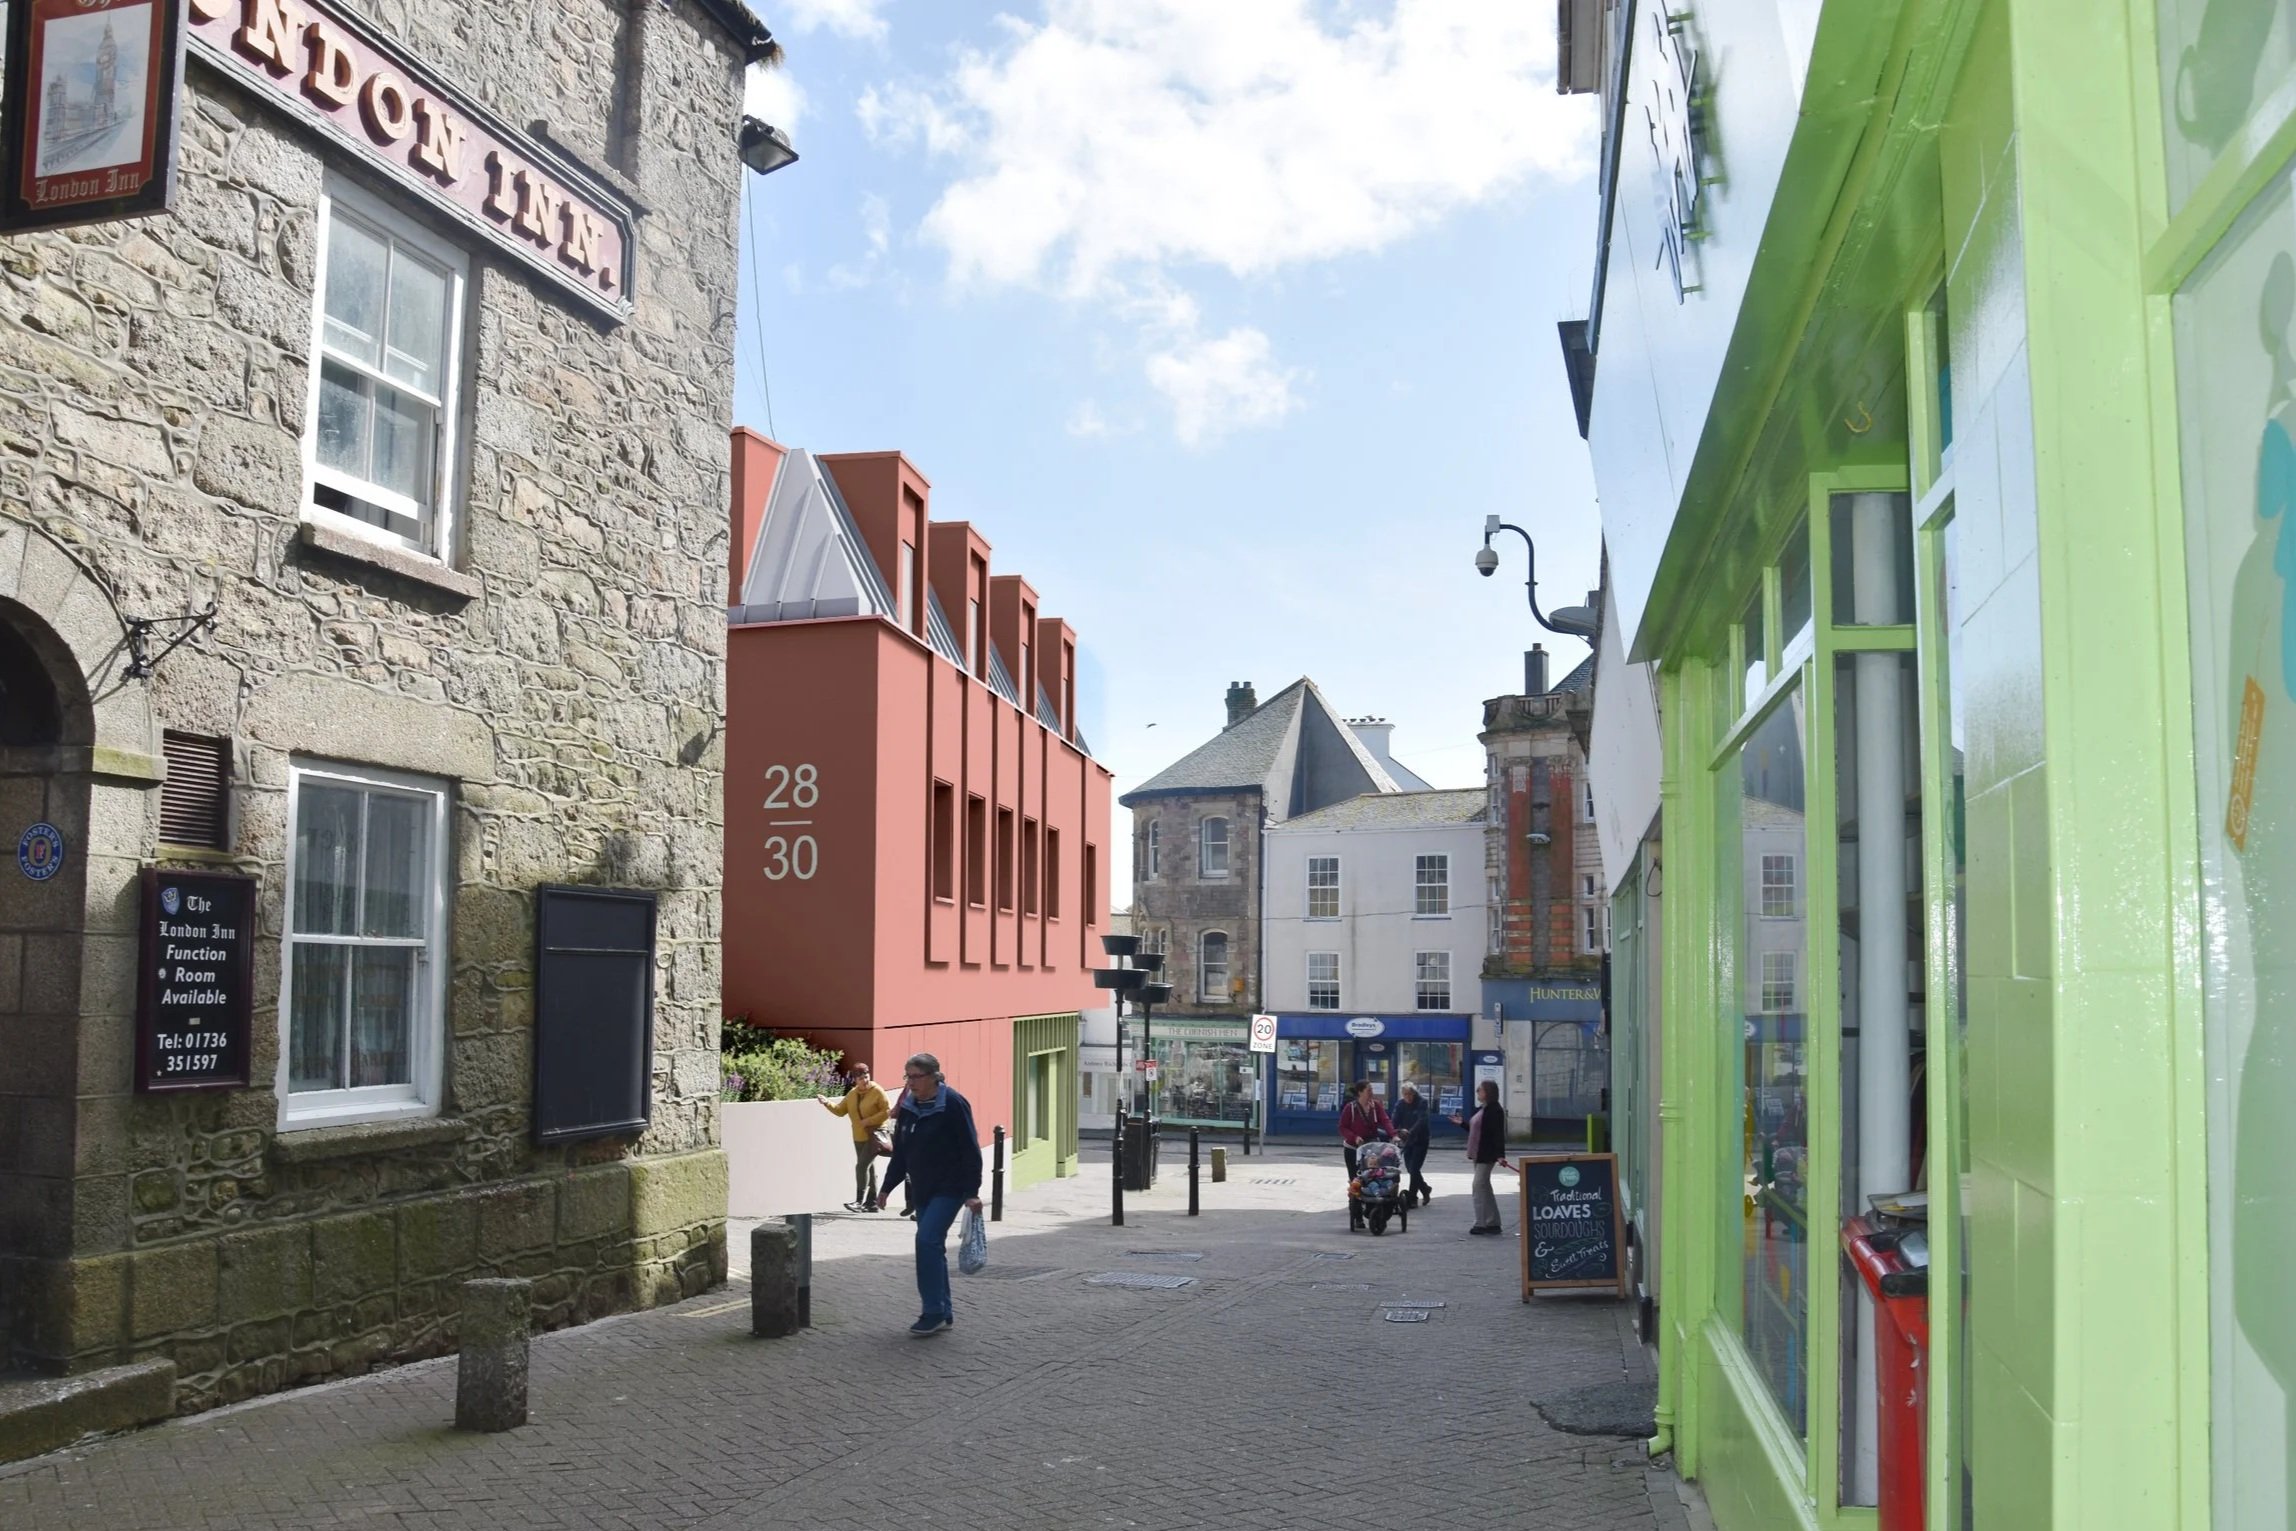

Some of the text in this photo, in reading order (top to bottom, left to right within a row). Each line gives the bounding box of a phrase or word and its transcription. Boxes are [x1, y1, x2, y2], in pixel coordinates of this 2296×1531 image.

[35, 168, 140, 204] London Inn
[763, 763, 819, 809] 28
[763, 835, 818, 880] 30
[187, 895, 212, 913] The
[159, 920, 236, 939] London Inn
[166, 944, 227, 961] Function
[175, 966, 216, 982] Room
[161, 988, 227, 1005] Available
[1256, 1024, 1272, 1035] 20
[157, 1032, 227, 1050] Tel: 01736
[1253, 1042, 1273, 1050] ZONE
[166, 1054, 218, 1072] 351597
[1532, 1203, 1592, 1220] LOAVES
